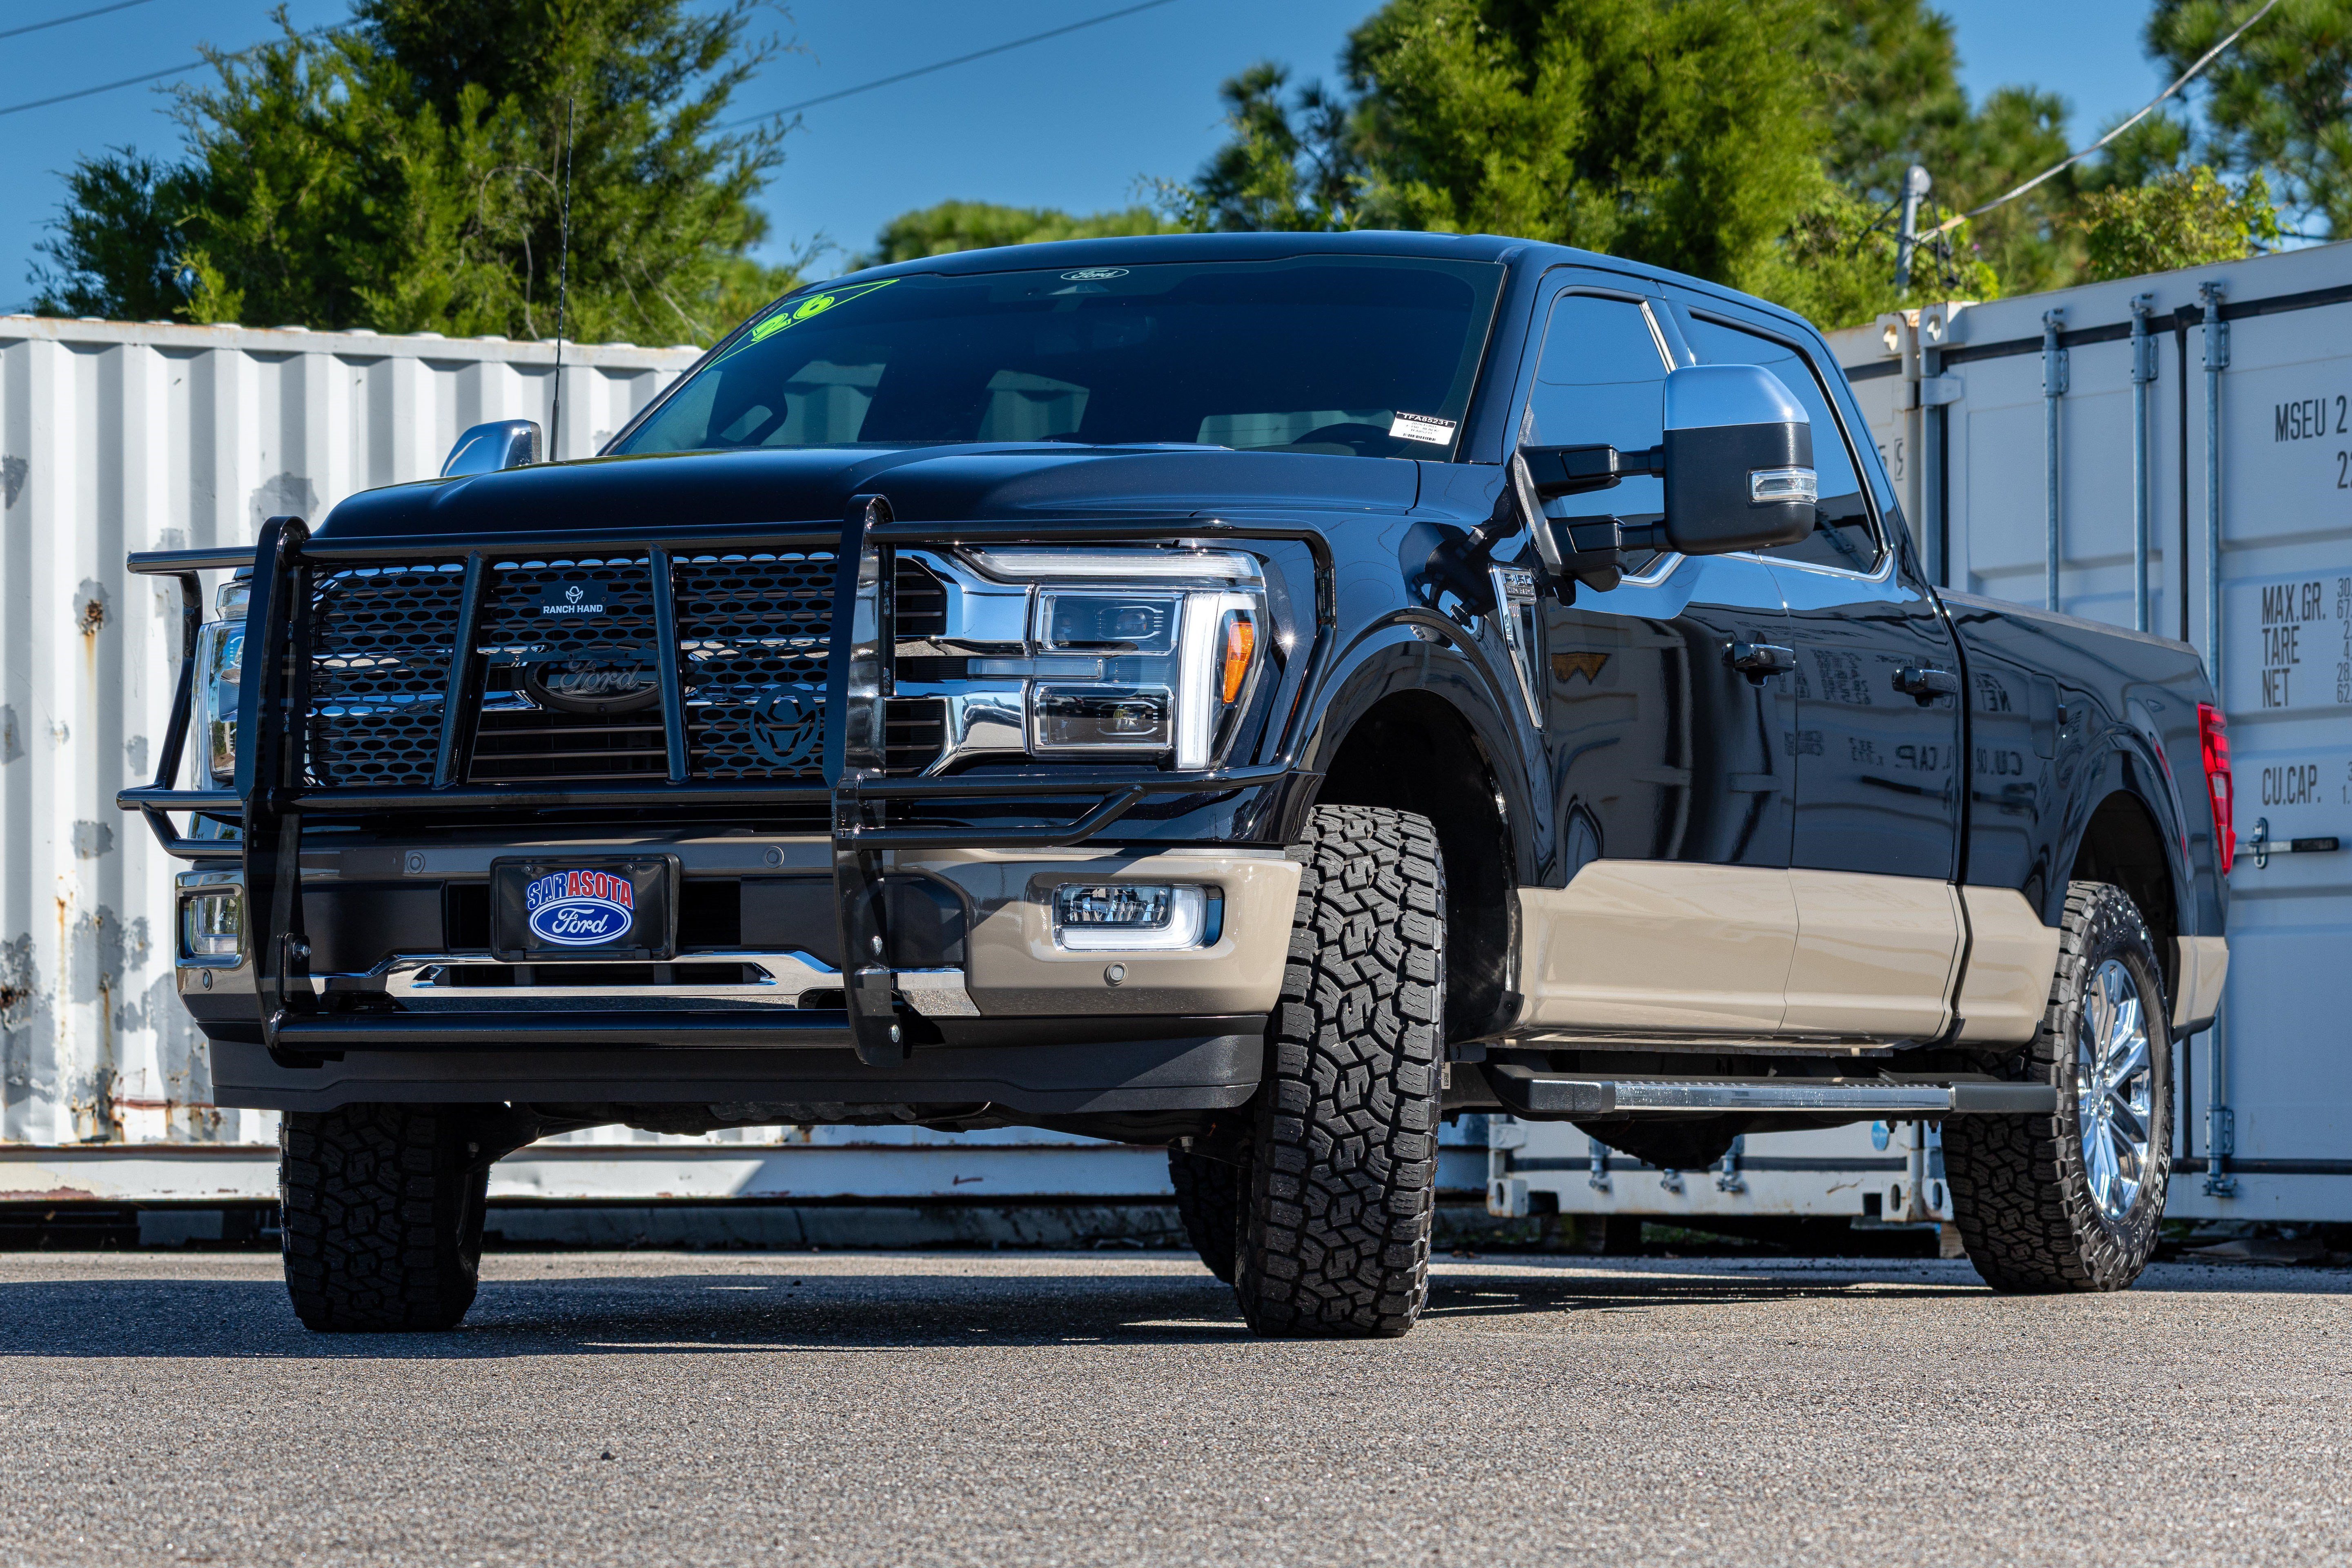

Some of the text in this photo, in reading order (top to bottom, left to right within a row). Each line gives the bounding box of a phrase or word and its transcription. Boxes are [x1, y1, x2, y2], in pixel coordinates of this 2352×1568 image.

[1071, 270, 1118, 278] Ford
[751, 294, 835, 341] 26
[1403, 413, 1449, 426] TFA85231
[2275, 398, 2326, 442] MSEU
[2337, 451, 2352, 489] 2
[543, 604, 603, 613] RANCH HAND
[2262, 582, 2326, 625] MAX.GR.
[2262, 626, 2300, 666] TARE
[559, 660, 643, 692] Ford
[2262, 668, 2290, 708] NET
[2262, 764, 2321, 806] CU.CAP.
[528, 871, 634, 910] SARASOTA
[552, 908, 609, 933] Ford
